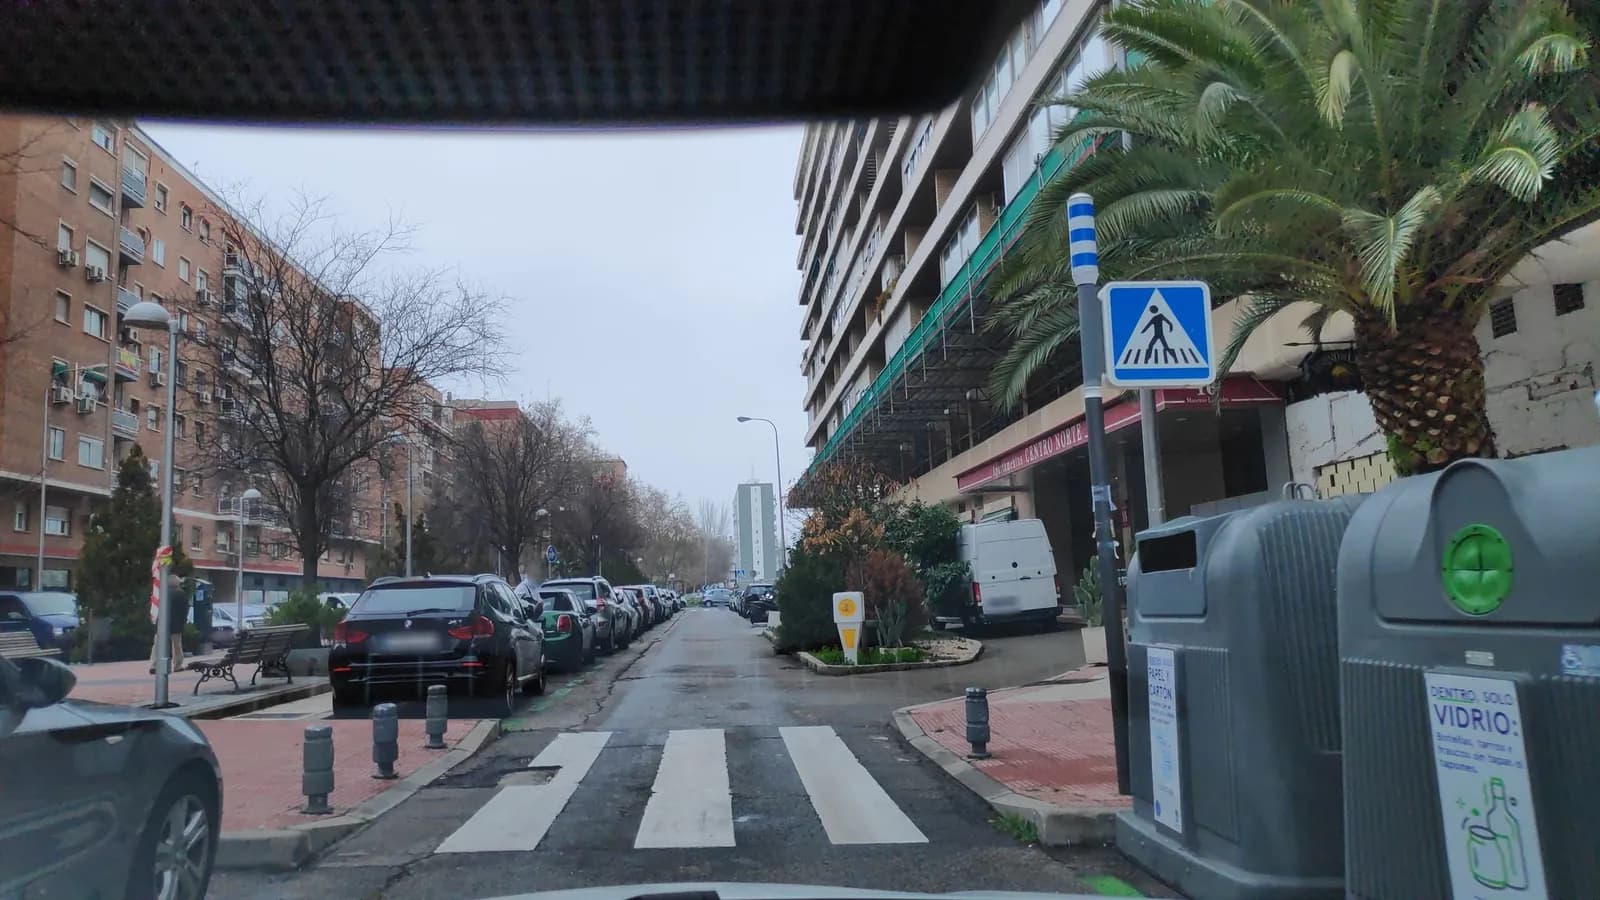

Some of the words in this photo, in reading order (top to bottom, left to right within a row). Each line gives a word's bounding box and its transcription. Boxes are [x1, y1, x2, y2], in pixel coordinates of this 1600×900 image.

[1024, 436, 1053, 463] CENTRO
[1055, 424, 1082, 450] NORTE
[1482, 691, 1513, 706] SOLO
[1433, 704, 1519, 736] VIDRIO:
